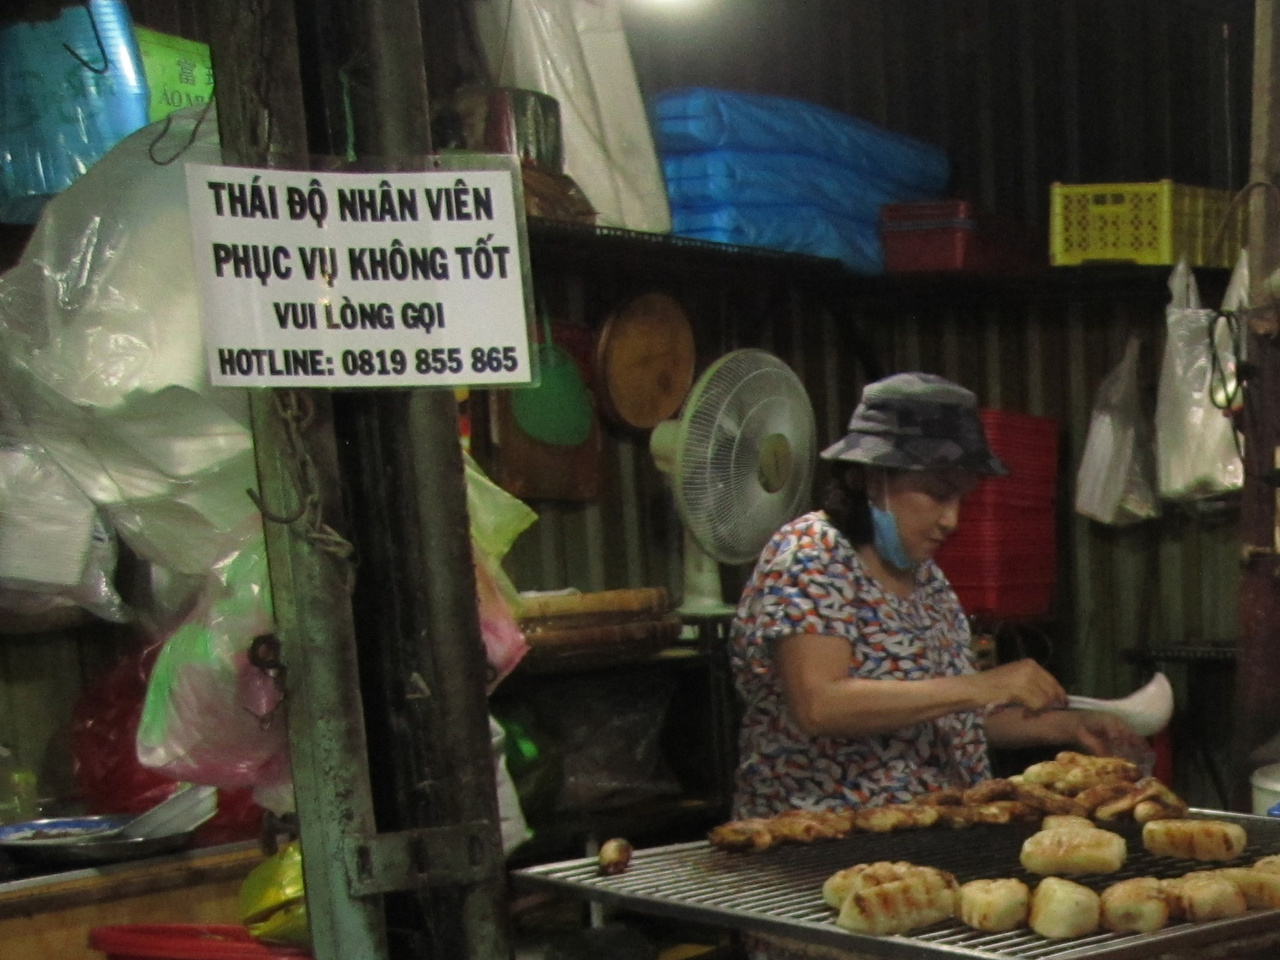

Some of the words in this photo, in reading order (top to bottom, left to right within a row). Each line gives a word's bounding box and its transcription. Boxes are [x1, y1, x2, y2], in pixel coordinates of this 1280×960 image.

[207, 175, 279, 219] THÁI
[287, 179, 327, 228] ĐỘ
[338, 180, 418, 222] NHÂN
[425, 179, 492, 220] VIÊN
[213, 243, 291, 286] PHỤC
[298, 247, 337, 287] VỤ
[348, 239, 448, 280] KHÔNG
[455, 234, 509, 279] TỐT
[274, 302, 317, 329] VUI
[325, 296, 394, 329] LÒNG
[401, 303, 444, 334] GỌI
[218, 349, 333, 376] HOTLINE:
[342, 349, 406, 375] 0819
[415, 349, 462, 374] 855
[471, 347, 517, 372] 865
